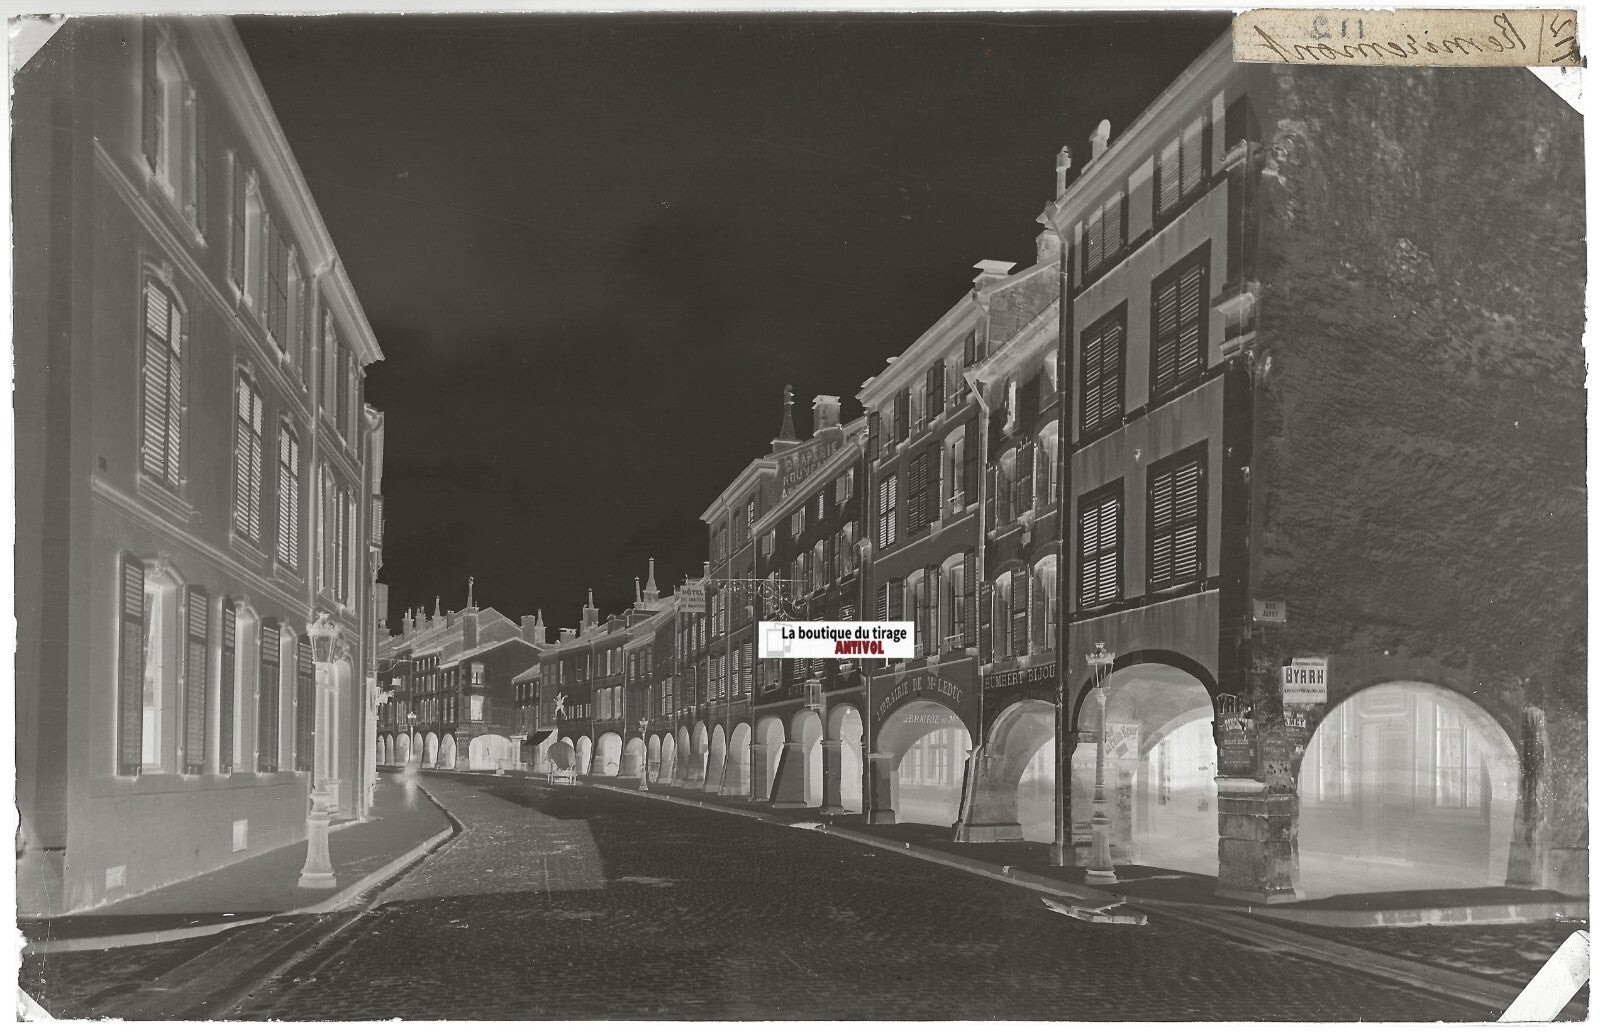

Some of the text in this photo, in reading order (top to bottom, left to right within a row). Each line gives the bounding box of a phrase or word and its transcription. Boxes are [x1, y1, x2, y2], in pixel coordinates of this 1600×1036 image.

[985, 670, 1024, 690] HUMBERT
[1285, 667, 1325, 684] BYRRH
[876, 681, 909, 721] LIBRAIRIE
[912, 677, 922, 691] DE
[938, 678, 963, 703] LEDUC
